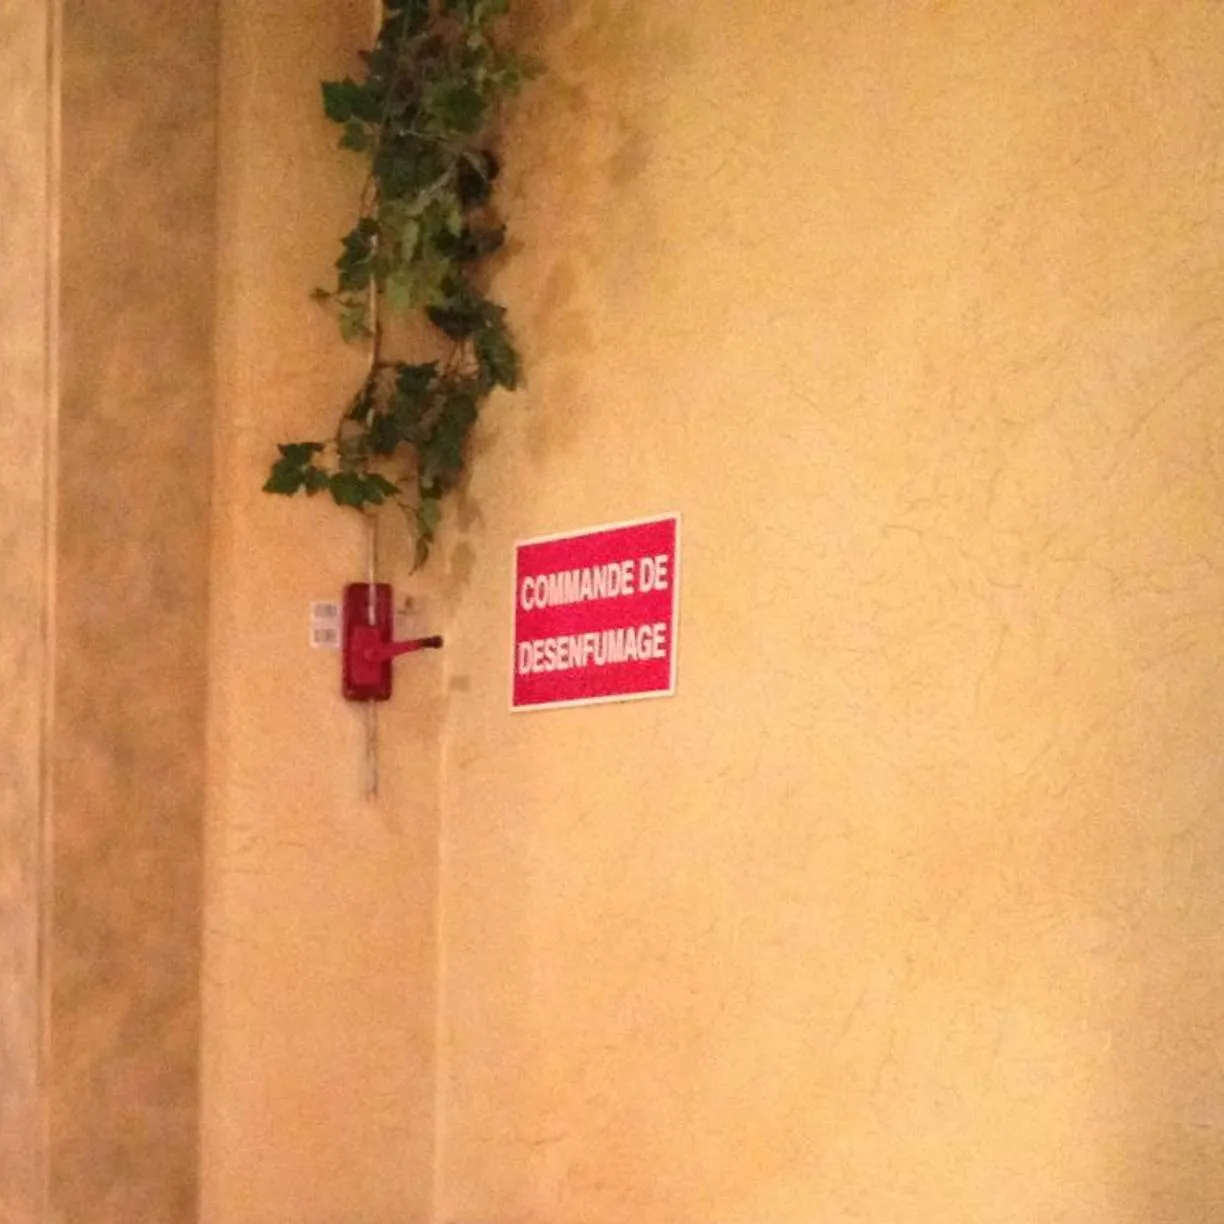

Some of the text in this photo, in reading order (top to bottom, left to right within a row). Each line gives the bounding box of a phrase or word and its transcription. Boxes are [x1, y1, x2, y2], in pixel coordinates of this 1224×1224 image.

[522, 554, 669, 611] COMMANDE DE
[518, 623, 667, 674] DESENFUMAGE
